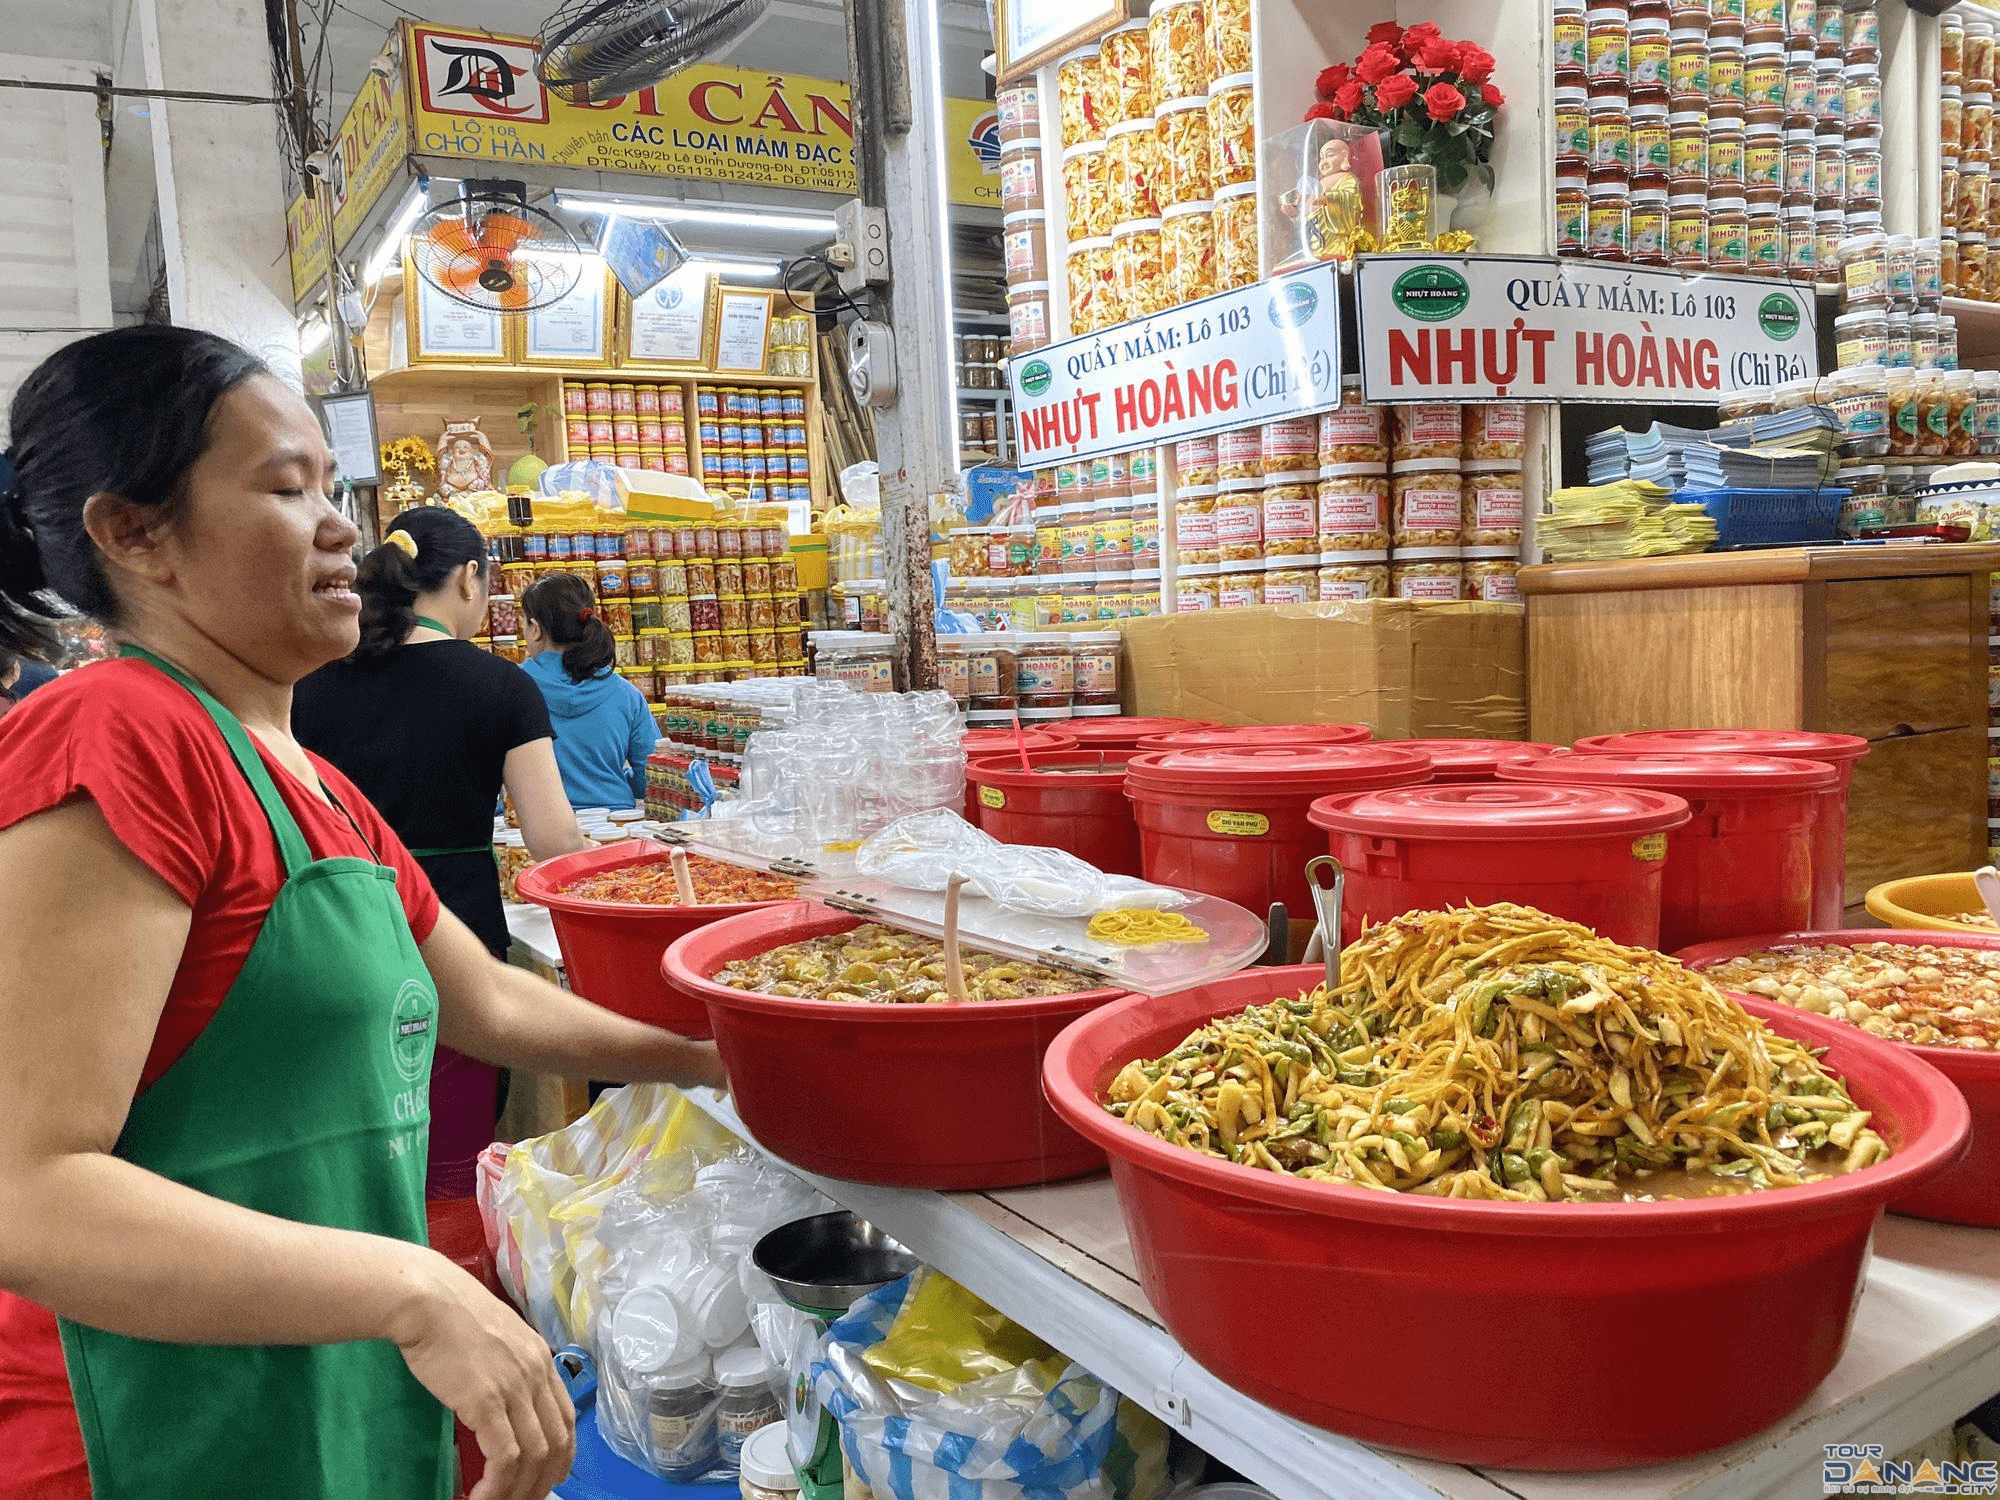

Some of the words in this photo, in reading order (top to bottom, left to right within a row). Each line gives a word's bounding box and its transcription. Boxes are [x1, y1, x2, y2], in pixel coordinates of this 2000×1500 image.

[489, 124, 517, 137] 108
[612, 120, 665, 146] CÁC
[672, 128, 729, 156] LOẠI
[491, 138, 545, 160] HÀN
[974, 186, 1003, 198] CH
[1671, 293, 1697, 318] Lô
[1703, 296, 1736, 321] 103
[1067, 337, 1119, 380] QUẦY
[1123, 323, 1182, 367] MẮM:
[1187, 318, 1212, 345] Lô
[1218, 305, 1251, 337] 103
[1388, 316, 1555, 397] NHỰT
[1575, 320, 1721, 391] HOÀNG
[1020, 387, 1101, 454] NHỰT
[1114, 358, 1238, 434] HOÀNG
[1243, 362, 1287, 408] (Chị
